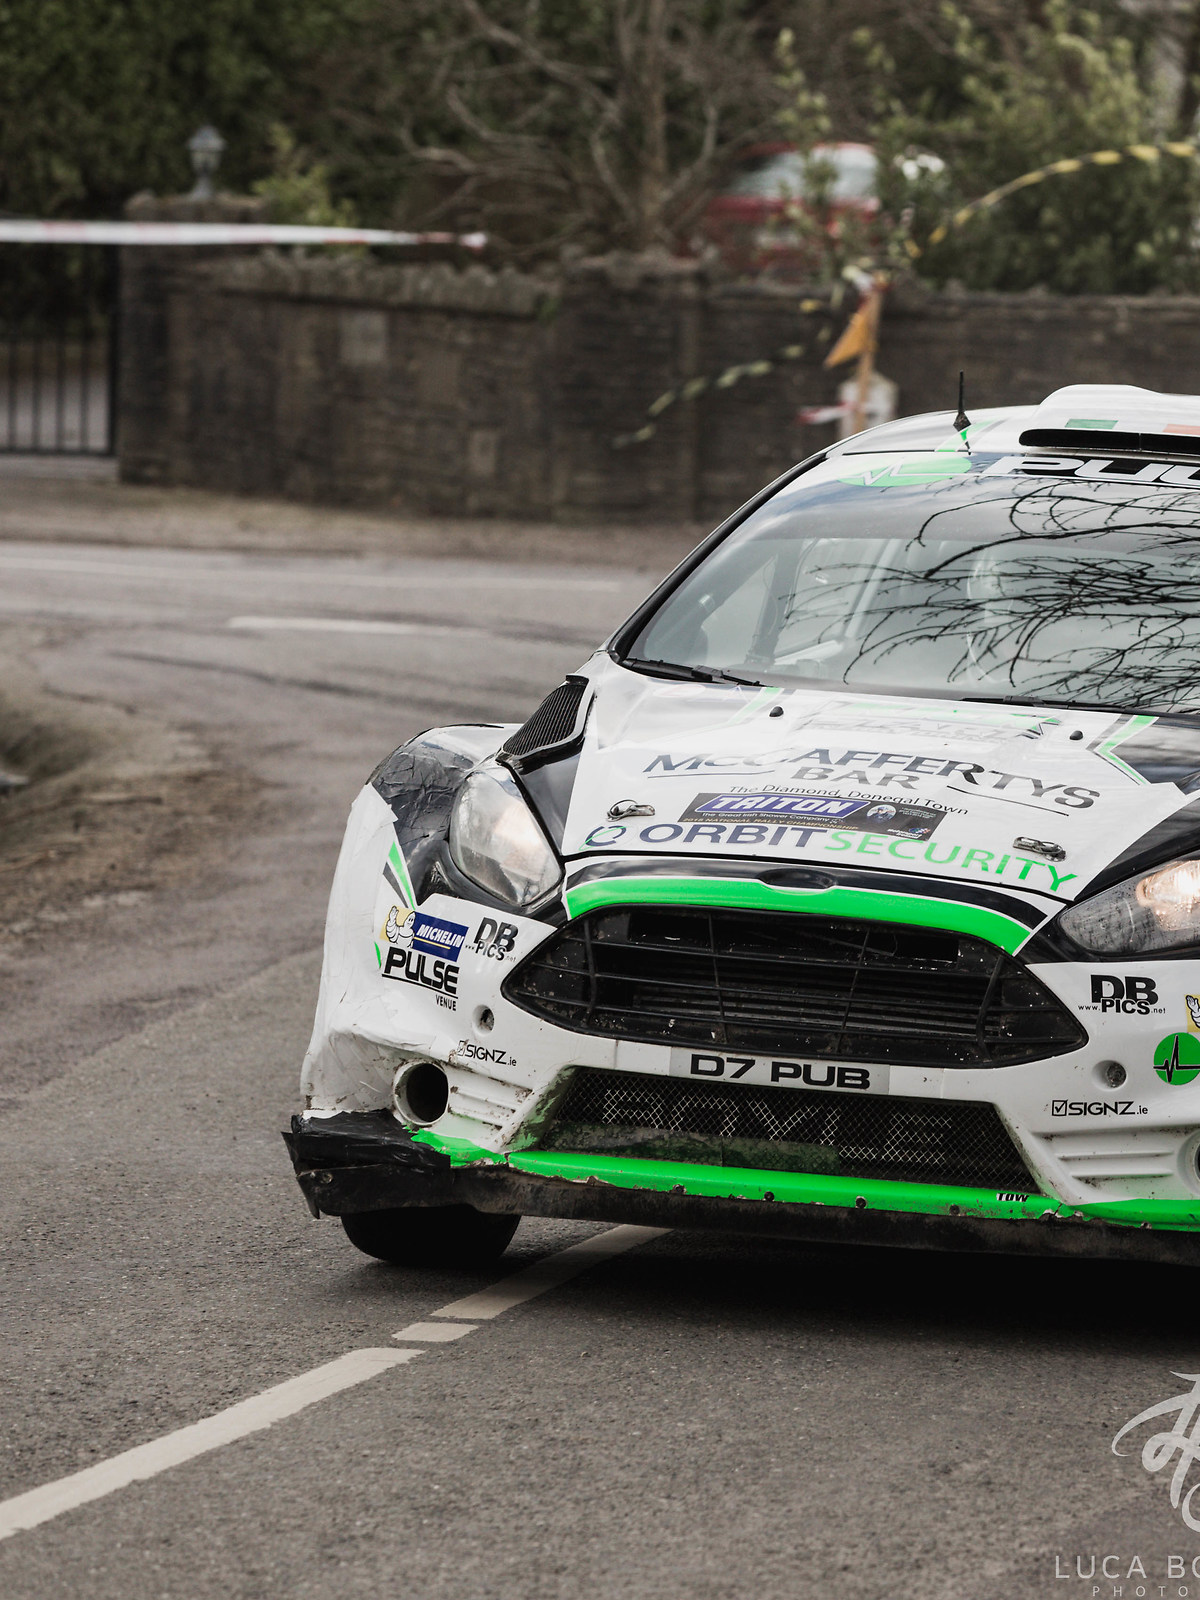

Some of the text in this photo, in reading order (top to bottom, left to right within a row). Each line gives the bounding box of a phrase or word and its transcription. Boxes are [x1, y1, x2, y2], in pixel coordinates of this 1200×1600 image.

[790, 766, 920, 790] BAR
[711, 796, 854, 814] TRITON
[730, 786, 758, 794] The
[762, 784, 843, 798] Diamond,
[849, 789, 920, 806] Donegal
[924, 798, 969, 815] Town
[786, 819, 859, 830] CHAMPIONSHIP
[790, 814, 830, 822] Company
[416, 924, 465, 948] MICHELIN
[473, 916, 519, 952] DB
[383, 946, 460, 995] PULSE
[1090, 974, 1160, 1005] DB
[436, 994, 458, 1012] VENUE
[465, 1043, 518, 1067] SIGNZ.ie
[690, 1053, 871, 1090] D7 PUB
[1067, 1100, 1149, 1117] SIGNZ.ie
[600, 1088, 954, 1166] BOYLE
[997, 1192, 1030, 1203] TOW
